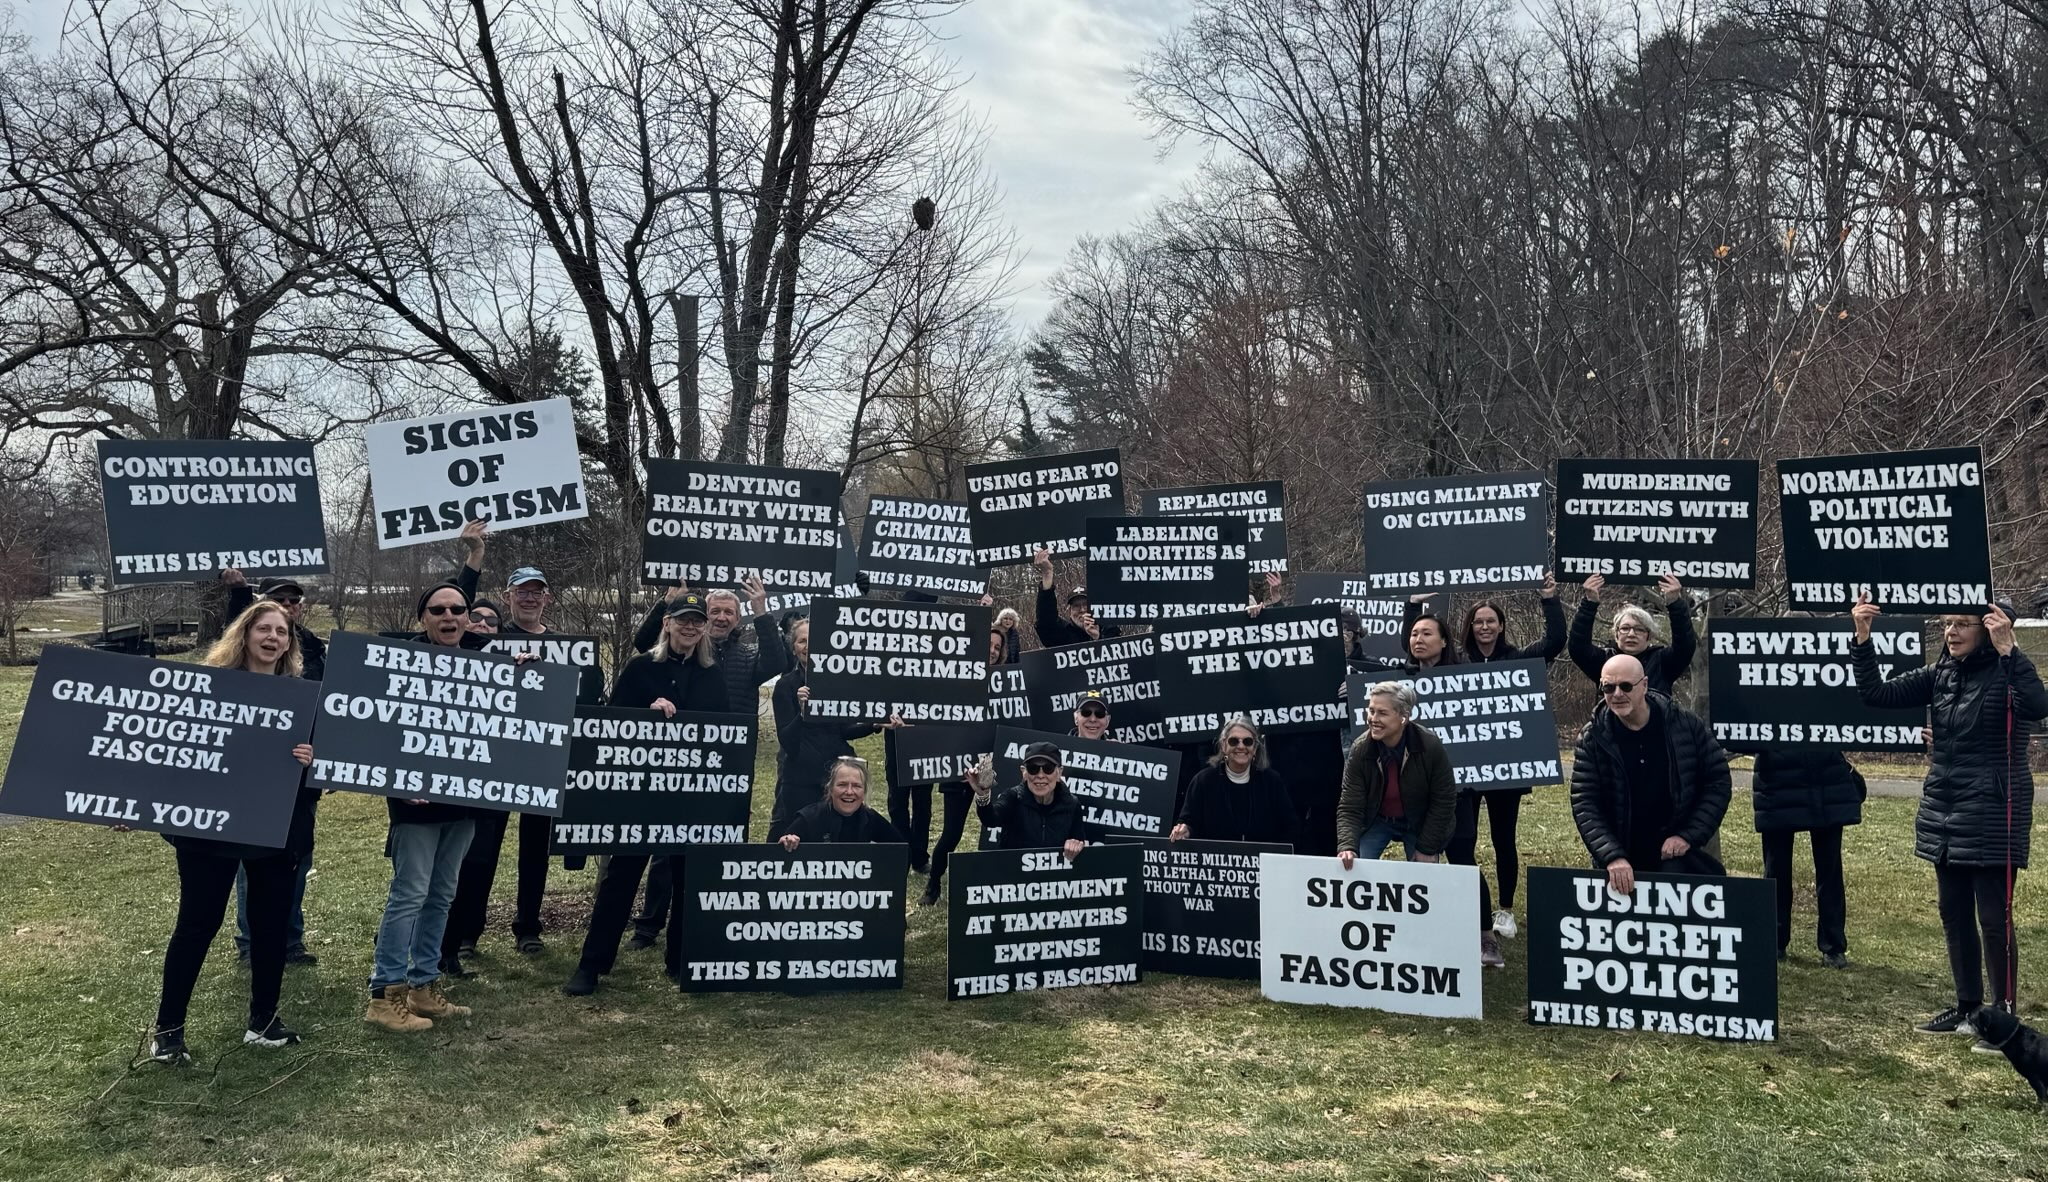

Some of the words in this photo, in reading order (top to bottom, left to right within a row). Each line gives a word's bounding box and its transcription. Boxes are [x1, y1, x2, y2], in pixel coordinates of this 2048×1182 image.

[403, 410, 538, 455] SIGNS
[104, 457, 313, 478] CONTROLLING
[448, 453, 504, 487] OF
[968, 472, 1032, 493] USING
[1036, 465, 1088, 485] FEAR
[1091, 462, 1118, 478] TO
[1781, 462, 1979, 495] NORMALIZING
[129, 483, 296, 505] EDUCATION
[688, 473, 800, 497] DENYING
[1583, 473, 1731, 491] MURDERING
[980, 493, 1032, 512] GAIN
[1037, 484, 1112, 506] POWER
[1158, 490, 1267, 511] REPLACING
[1366, 490, 1430, 508] USING
[1434, 482, 1542, 504] MILITARY
[1809, 494, 1952, 521] POLITICAL
[381, 482, 581, 540] FASCISM
[653, 494, 760, 518] REALITY
[763, 502, 832, 523] WITH
[869, 499, 970, 523] PARDONI
[1383, 514, 1413, 529] ON
[1417, 506, 1526, 527] CIVILIANS
[1565, 499, 1673, 517] CITIZENS
[1679, 501, 1749, 518] WITH
[647, 518, 779, 543] CONSTANT
[783, 527, 835, 547] LIES
[875, 517, 972, 544] CRIMINA
[1116, 526, 1218, 541] LABELING
[1593, 525, 1717, 544] IMPUNITY
[1814, 525, 1949, 549] VIOLENCE
[115, 553, 181, 574] THIS
[186, 552, 212, 571] IS
[217, 548, 325, 570] FASCISM
[976, 545, 1021, 563] THIS
[1025, 543, 1042, 557] IS
[1046, 537, 1086, 553] FASC
[1089, 545, 1217, 561] MINORITIES
[1221, 545, 1246, 560] AS
[645, 562, 701, 580] THIS
[706, 565, 729, 582] IS
[734, 568, 832, 588] FASCISM
[1121, 566, 1214, 581] ENEMIES
[1370, 572, 1420, 589] THIS
[1424, 570, 1445, 586] IS
[1449, 565, 1544, 584] FASCISM
[1561, 557, 1614, 575] THIS
[1620, 559, 1641, 575] IS
[1647, 560, 1750, 579] FASCISM
[897, 573, 912, 586] IS
[915, 575, 985, 594] FASCISM
[1342, 581, 1366, 596] FIR
[1792, 583, 1845, 603] THIS
[1850, 583, 1873, 603] IS
[1877, 583, 1987, 605] FASCISM
[836, 607, 965, 631] ACCUSING
[1090, 604, 1136, 618] THIS
[1140, 604, 1158, 618] IS
[830, 630, 933, 653] OTHERS
[938, 636, 970, 655] OF
[1160, 618, 1338, 652] SUPPRESSING
[1712, 632, 1921, 655] REWRITNG
[1054, 638, 1154, 669] DECLARING
[1188, 652, 1240, 674] THE
[1244, 646, 1314, 669] VOTE
[364, 643, 515, 686] ERASING
[521, 669, 544, 691] &
[810, 654, 881, 675] YOUR
[887, 657, 986, 680] CRIMES
[1086, 663, 1130, 685] FAKE
[149, 667, 211, 694] OUR
[52, 679, 294, 731] GRANDPARENTS
[386, 674, 517, 713] FAKING
[324, 692, 568, 747] GOVERNMENT
[808, 700, 860, 717] THIS
[865, 702, 886, 718] IS
[891, 703, 984, 722] FASCISM
[1165, 713, 1219, 733] THIS
[1249, 702, 1348, 726] FASCISM
[103, 712, 232, 747] FOUGHT
[572, 718, 698, 742] IGNORING
[703, 724, 748, 744] DUE
[1115, 722, 1164, 744] FASCI
[1434, 721, 1523, 744] ALISTS
[1713, 723, 1773, 741] THIS
[1779, 724, 1804, 741] IS
[1809, 725, 1924, 744] FASCISM
[88, 736, 229, 773] FASCISM.
[401, 730, 491, 763] DATA
[596, 745, 702, 767] PROCESS
[706, 751, 722, 768] &
[909, 756, 952, 780] THIS
[956, 755, 972, 776] IS
[1453, 760, 1559, 784] FASCISM
[313, 759, 387, 787] THIS
[393, 769, 423, 792] IS
[429, 774, 559, 808] FASCISM
[565, 770, 645, 791] COURT
[649, 773, 749, 793] RULINGS
[1061, 776, 1140, 803] MESTIC
[65, 791, 141, 820] WILL
[152, 802, 230, 831] YOU?
[555, 824, 614, 843] THIS
[619, 825, 642, 843] IS
[647, 825, 744, 843] FASCISM
[722, 861, 872, 879] DECLARING
[1144, 850, 1167, 863] ING
[1171, 852, 1198, 865] THE
[1202, 853, 1260, 868] MILITAR
[1143, 865, 1160, 878] OR
[1163, 866, 1215, 881] LETHAL
[699, 892, 760, 910] WAR
[767, 891, 893, 910] WITHOUT
[967, 878, 1127, 905] ENRICHMENT
[1144, 880, 1191, 894] THOUT
[1194, 883, 1204, 895] A
[1208, 884, 1250, 898] STATE
[1307, 878, 1429, 915] SIGNS
[1573, 877, 1725, 919] USING
[1183, 897, 1214, 911] WAR
[726, 921, 863, 941] CONGRESS
[966, 915, 995, 935] AT
[1001, 906, 1127, 932] TAXPAYERS
[1172, 935, 1190, 954] IS
[1196, 937, 1262, 958] FASCIS
[1341, 921, 1395, 952] OF
[1560, 916, 1742, 961] SECRET
[995, 938, 1100, 963] EXPENSE
[688, 961, 750, 980] THIS
[756, 961, 781, 979] IS
[787, 959, 897, 979] FASCISM
[954, 974, 1009, 996] THIS
[1015, 972, 1037, 993] IS
[1042, 963, 1137, 985] FASCISM
[1280, 954, 1460, 998] FASCISM
[1563, 957, 1738, 1003] POLICE
[1531, 1001, 1600, 1027] THIS
[1607, 1007, 1635, 1030] IS
[1642, 1010, 1774, 1043] FASCISM
